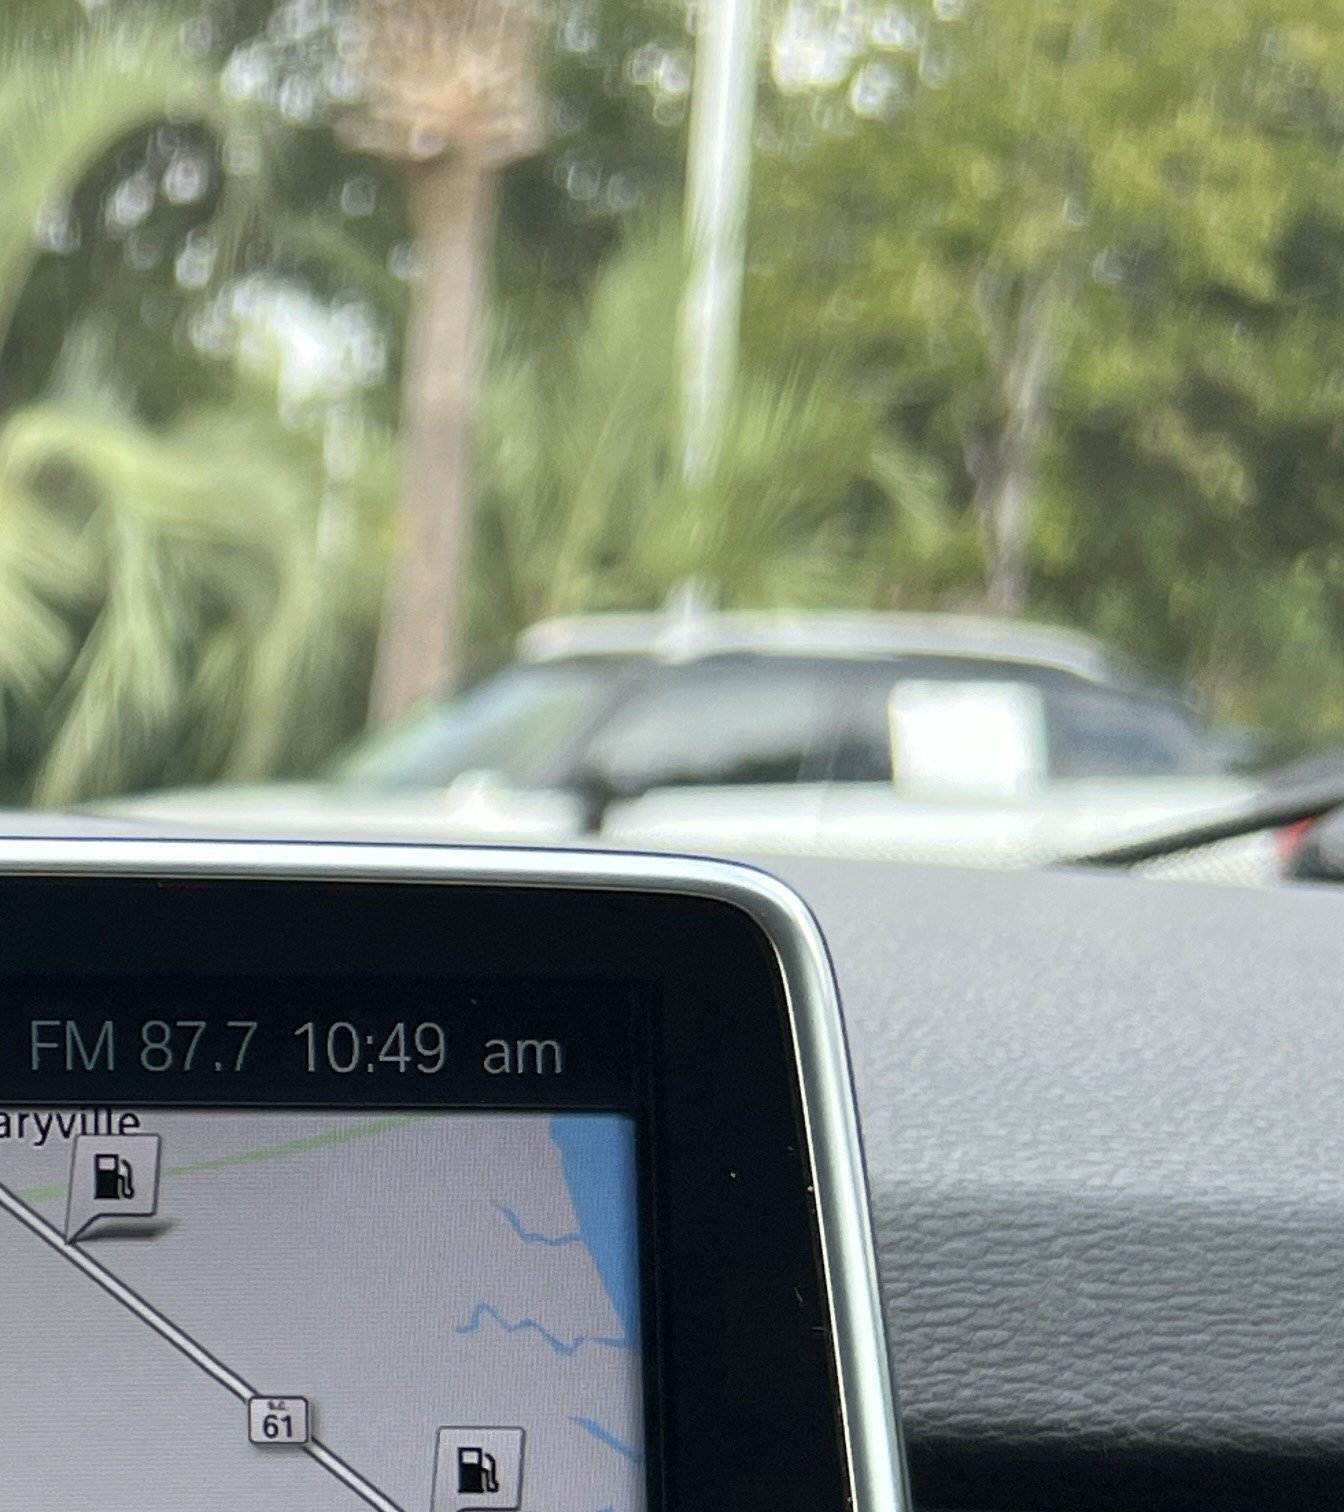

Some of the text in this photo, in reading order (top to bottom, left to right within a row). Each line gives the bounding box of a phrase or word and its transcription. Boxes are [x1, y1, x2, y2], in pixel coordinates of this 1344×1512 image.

[30, 1020, 259, 1073] FM 87.7
[294, 1022, 563, 1075] 10:49 am
[263, 1414, 293, 1439] 61
